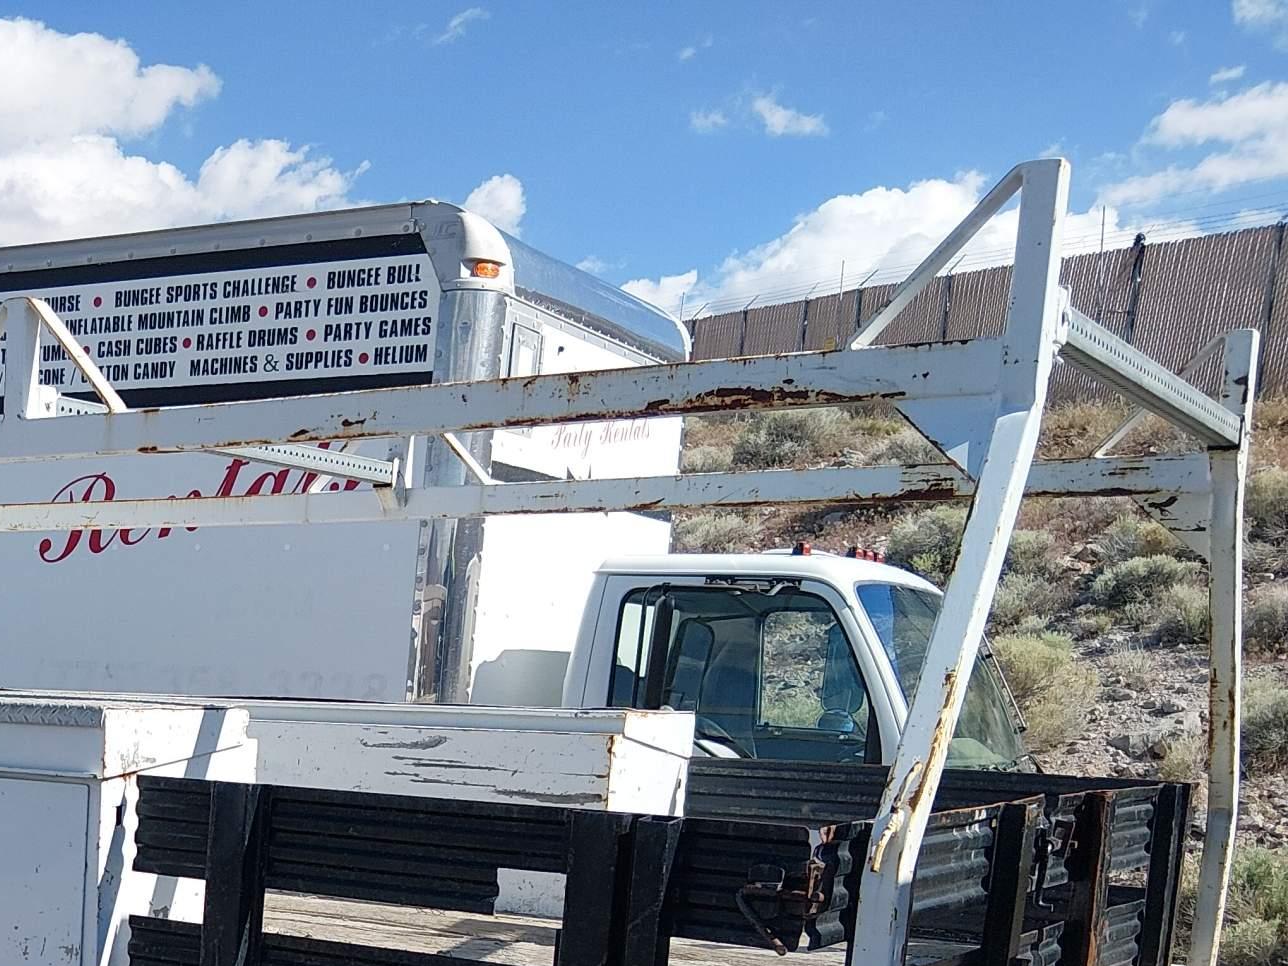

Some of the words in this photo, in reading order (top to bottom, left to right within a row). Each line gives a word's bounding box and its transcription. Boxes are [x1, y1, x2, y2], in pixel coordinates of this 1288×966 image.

[115, 287, 161, 308] BUNGEE
[166, 282, 218, 303] SPORTS
[223, 275, 297, 299] CHALLENGE
[327, 267, 381, 290] BUNGEE
[386, 264, 421, 284] BULL
[138, 309, 204, 331] MOUNTAIN
[210, 305, 251, 325] CLIMB
[275, 299, 321, 320] PARTY
[327, 296, 354, 316] FUN
[359, 290, 429, 314] BOUNCES
[98, 339, 131, 358] CASH
[136, 336, 178, 356] CUBES
[196, 331, 243, 352] RAFFLE
[248, 327, 299, 348] DRUMS
[324, 321, 373, 342] PARTY
[378, 317, 432, 339] GAMES
[133, 361, 176, 381] CANDY
[190, 355, 258, 377] MACHINES
[263, 354, 279, 373] &
[286, 349, 353, 371] SUPPLIES
[374, 344, 428, 366] HELIUM
